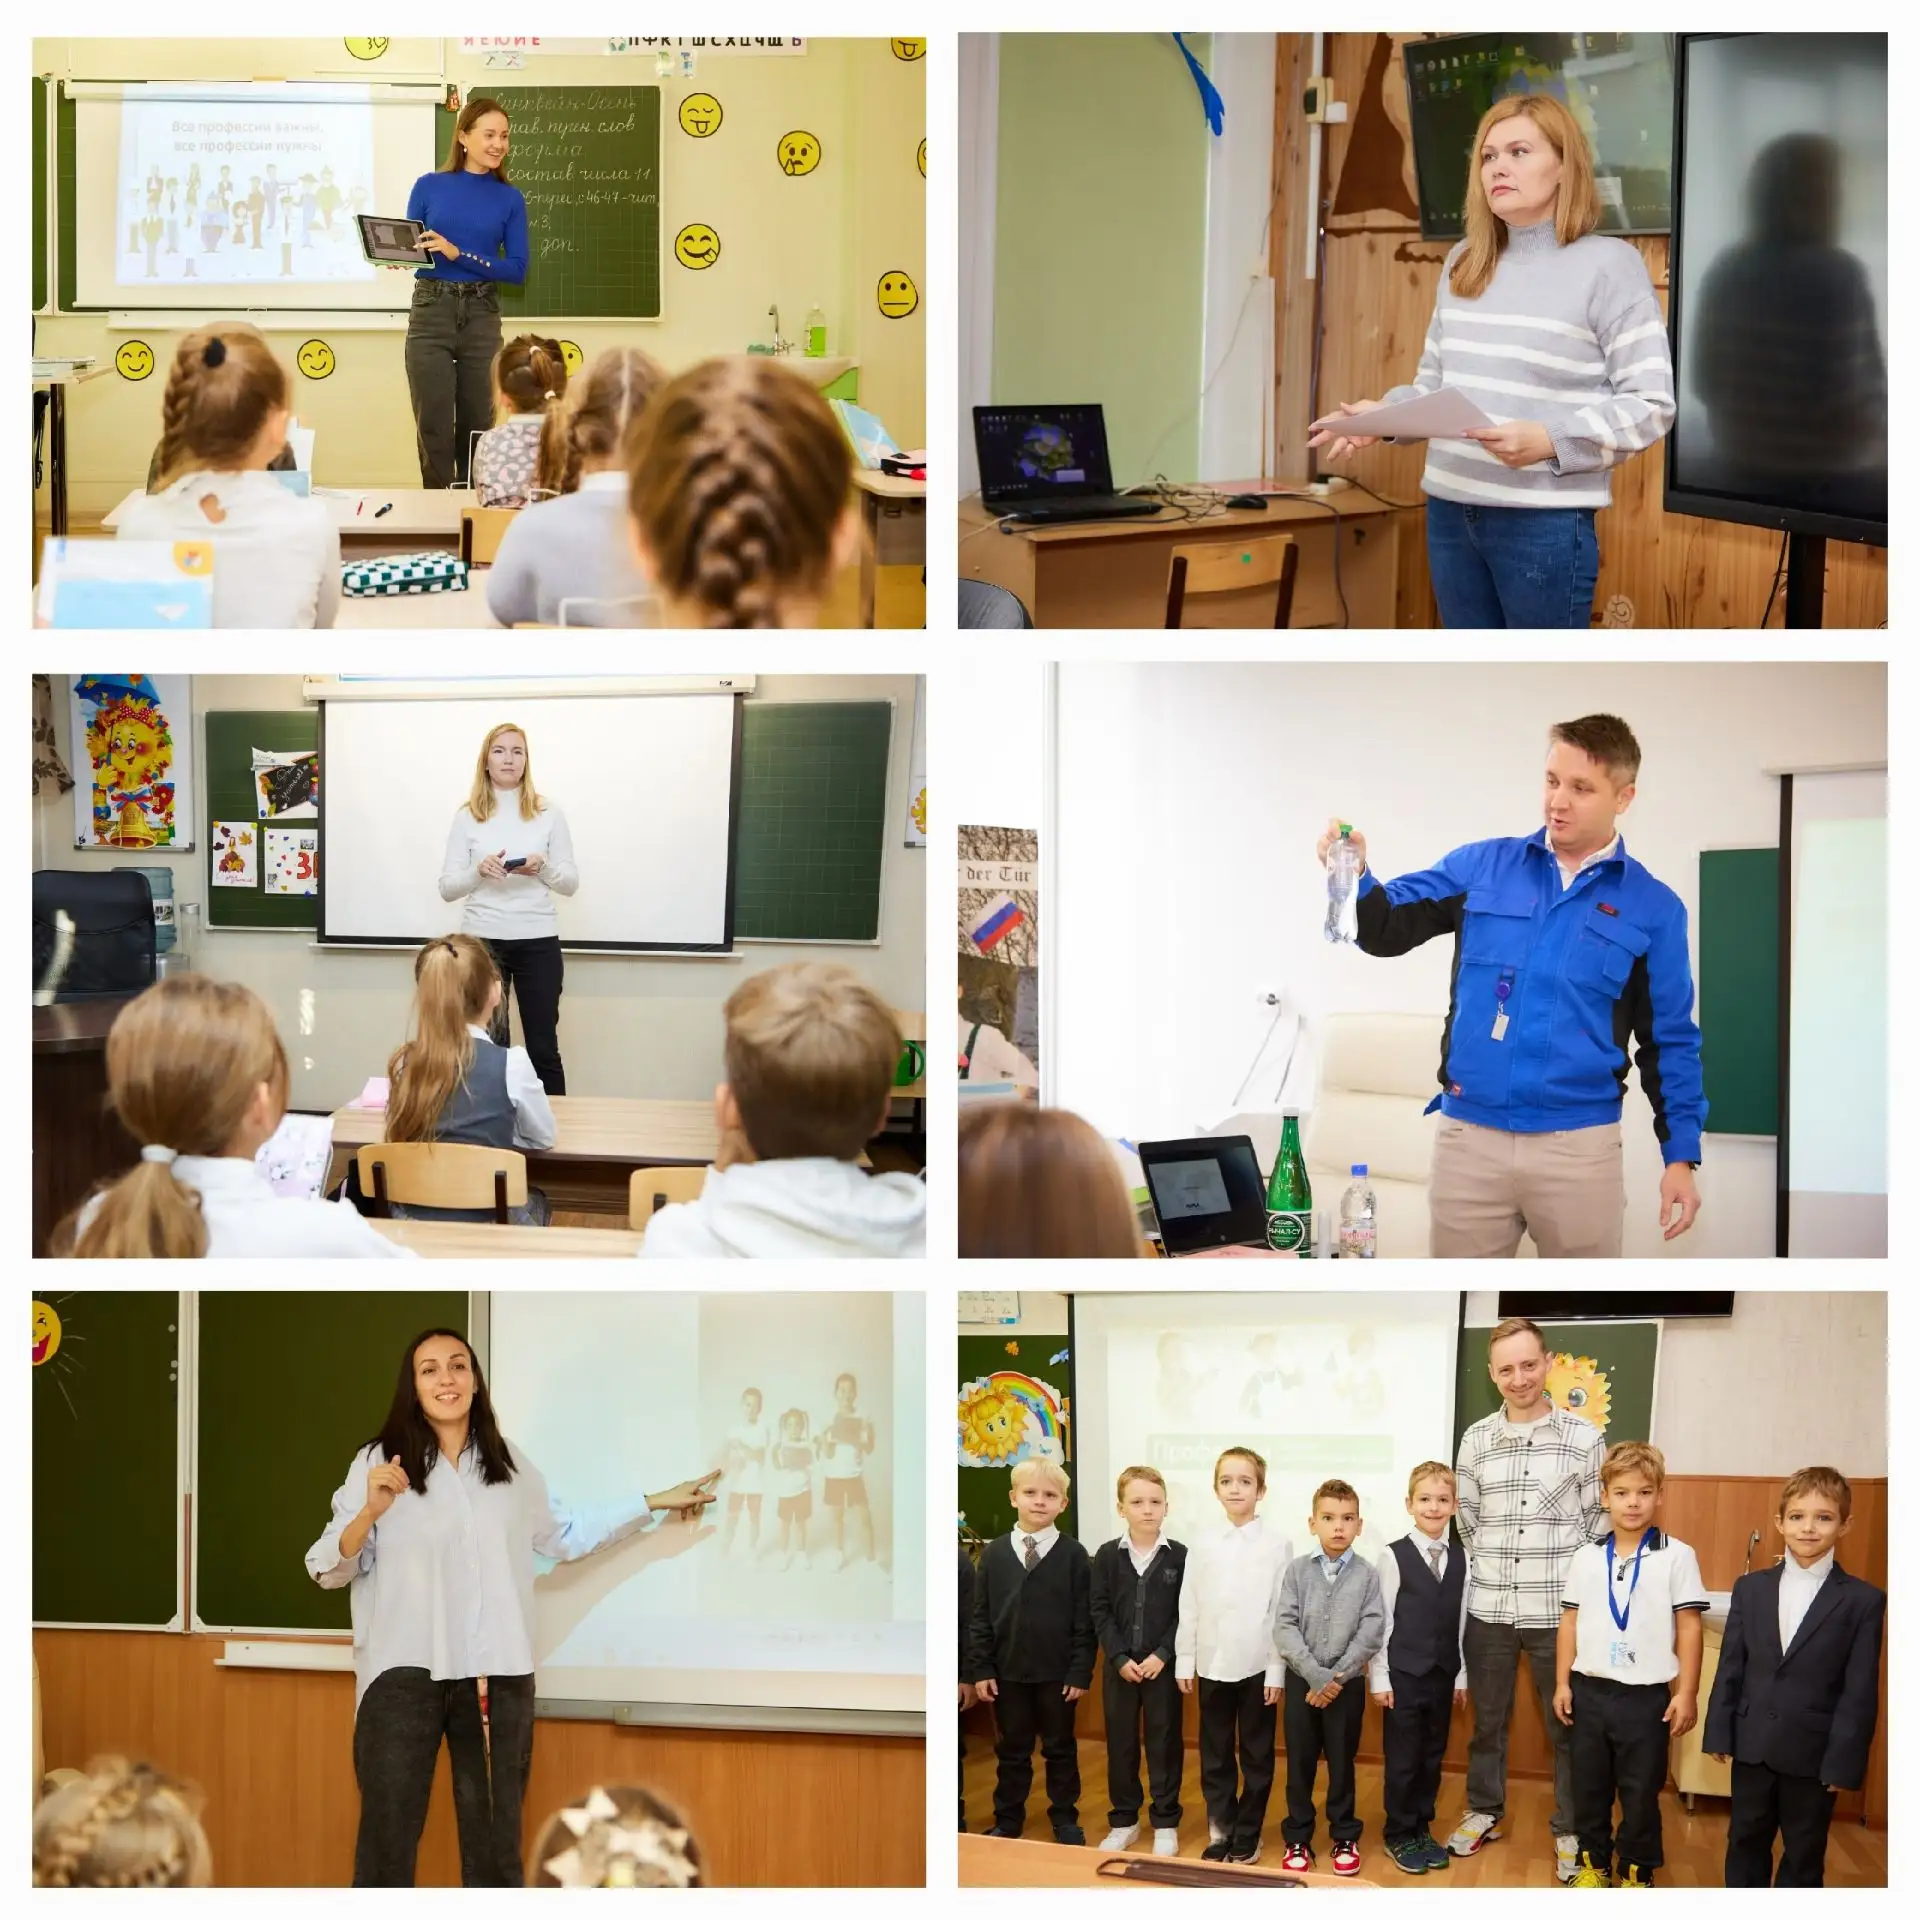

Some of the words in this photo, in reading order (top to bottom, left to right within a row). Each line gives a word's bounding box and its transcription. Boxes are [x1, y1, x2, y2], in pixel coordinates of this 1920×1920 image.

[171, 121, 195, 132] Все
[198, 121, 271, 136] профессии
[598, 112, 636, 133] слов
[174, 142, 196, 152] все
[199, 141, 272, 155] профессии
[507, 160, 576, 182] состав
[966, 865, 992, 881] der
